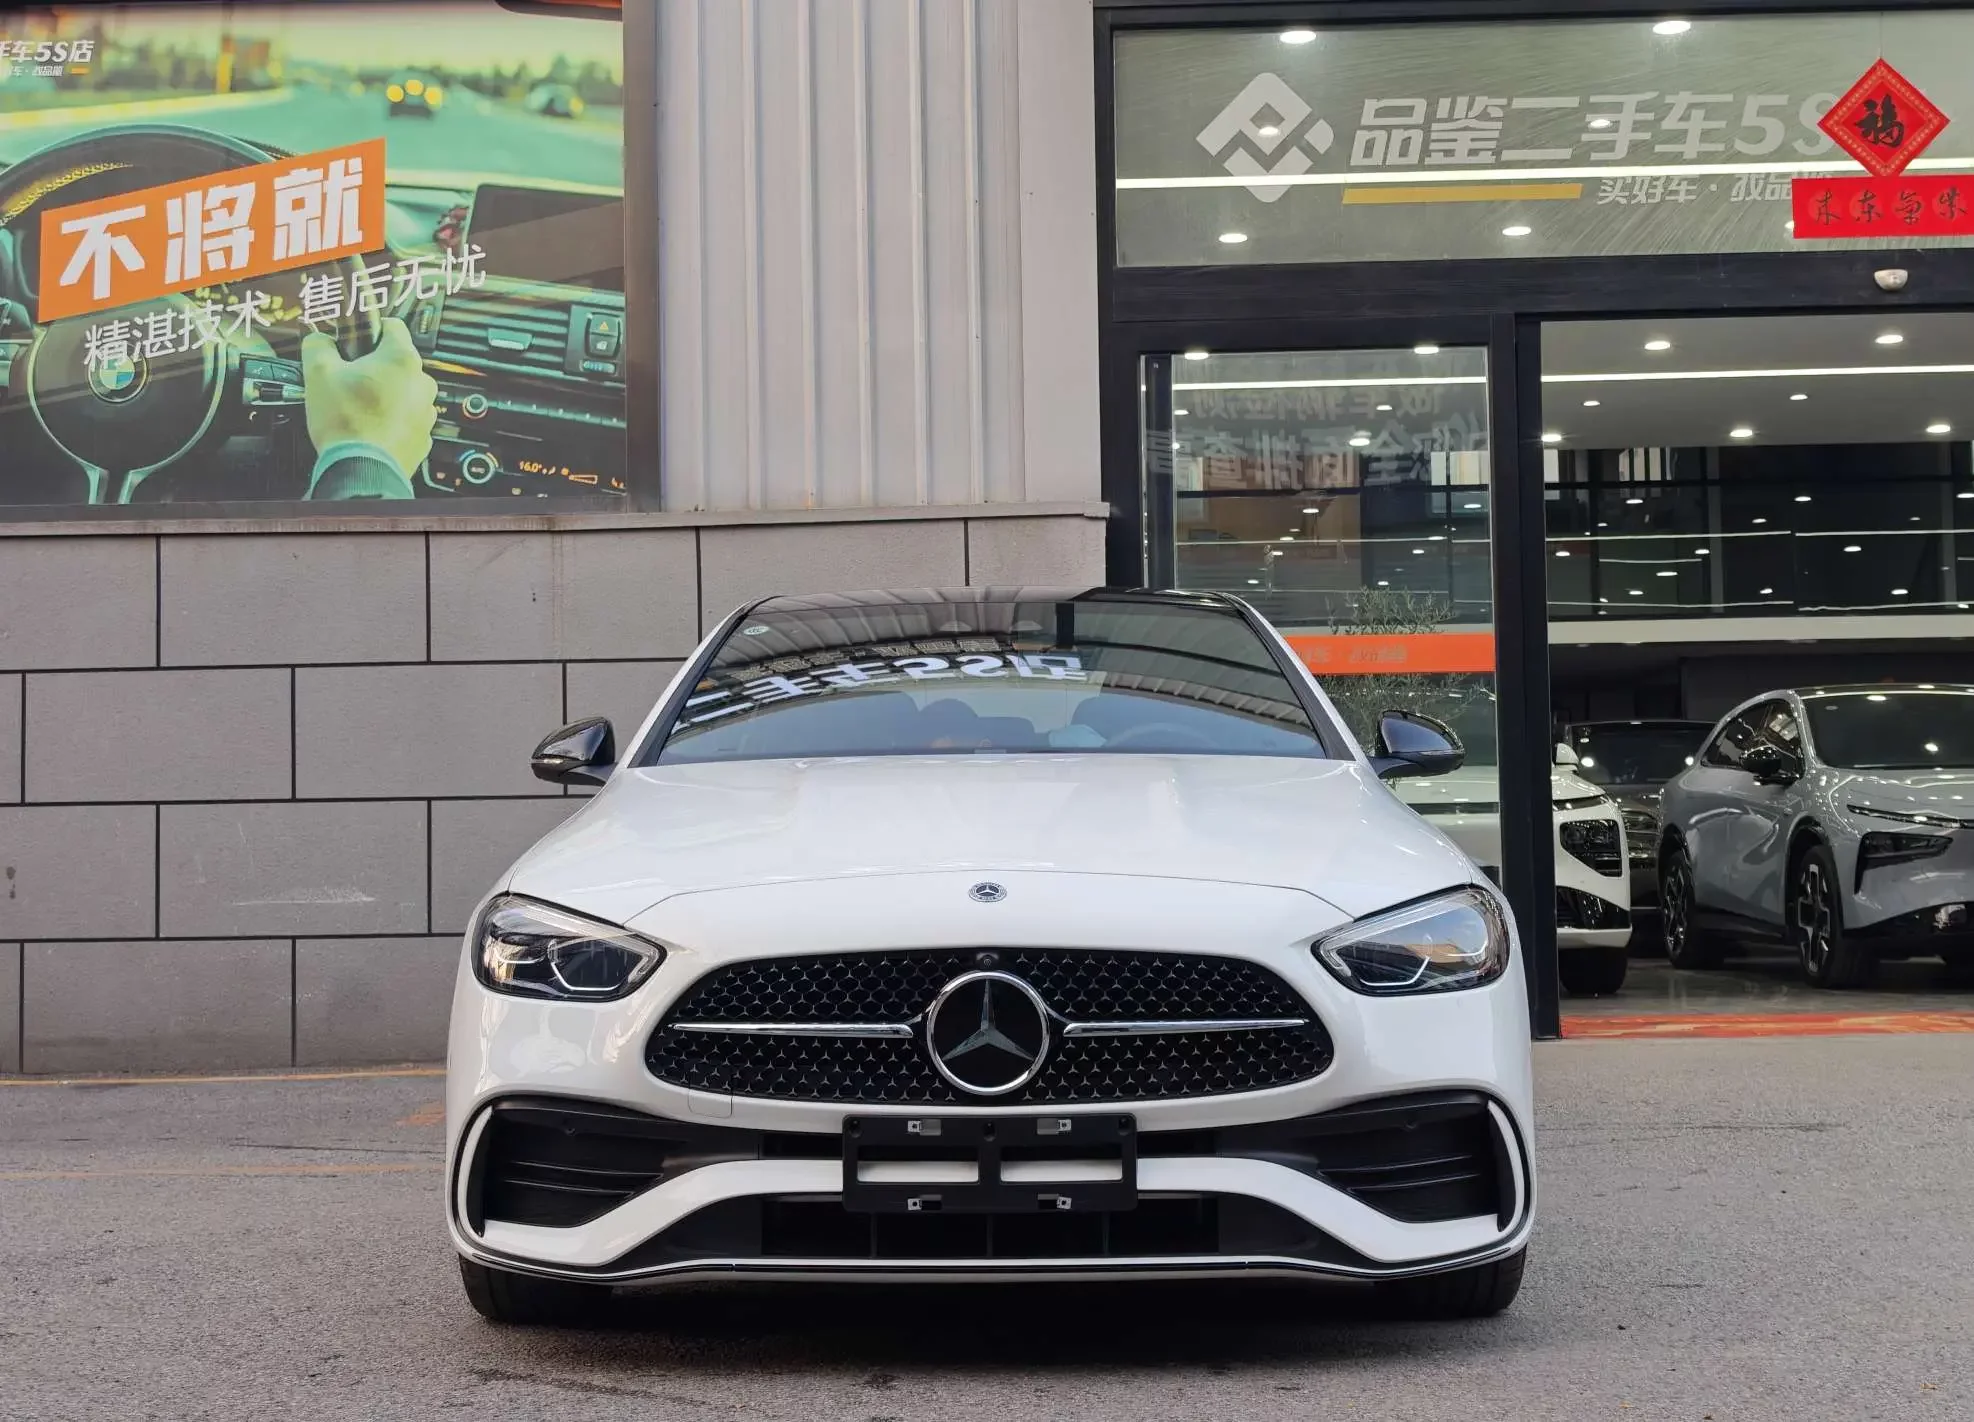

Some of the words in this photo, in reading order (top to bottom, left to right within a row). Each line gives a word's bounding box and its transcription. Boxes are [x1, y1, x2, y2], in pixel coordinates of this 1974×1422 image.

[1350, 90, 1838, 167] 品鉴二手车5S
[1853, 93, 1905, 149] 福
[59, 154, 364, 301] 不将就
[83, 288, 272, 371] 精湛技术
[299, 243, 487, 325] 售后无忧
